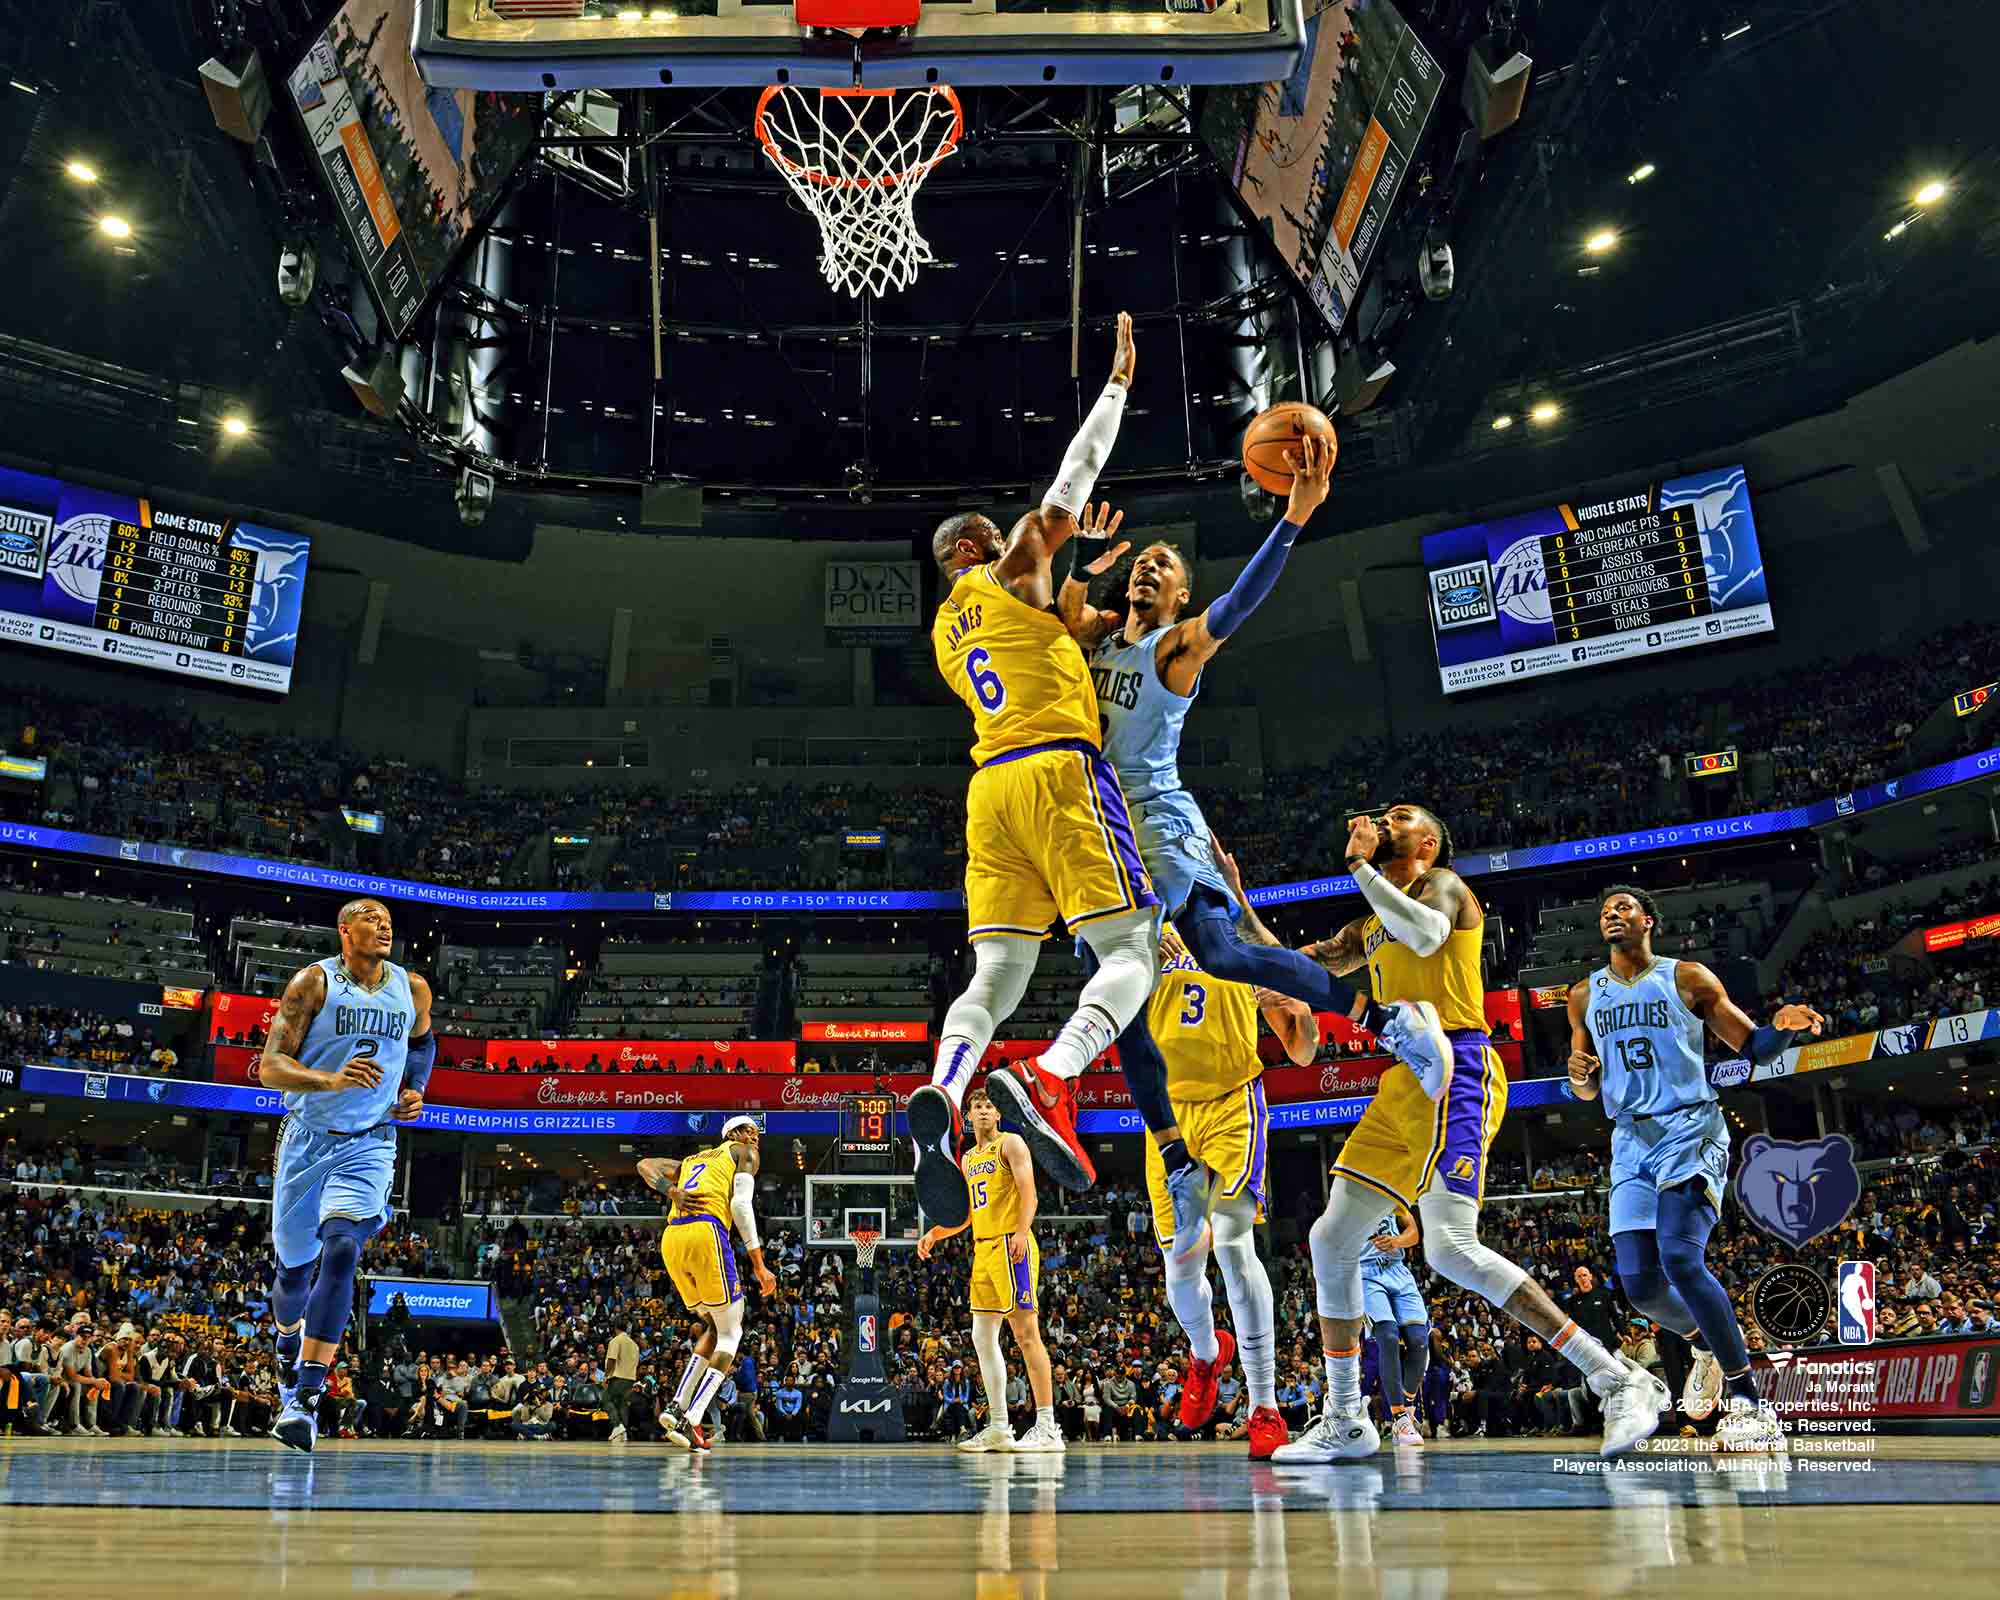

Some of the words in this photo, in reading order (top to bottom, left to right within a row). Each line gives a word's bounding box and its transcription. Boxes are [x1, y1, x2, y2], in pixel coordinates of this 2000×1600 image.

[1388, 77, 1417, 129] 7:00
[154, 512, 186, 531] GAME
[188, 519, 222, 537] STATS
[1578, 501, 1615, 521] HUSTLE
[1617, 494, 1648, 512] STATS
[117, 524, 140, 539] 60%
[150, 531, 176, 547] FIELD
[178, 538, 210, 554] GOALS
[211, 546, 220, 556] %
[230, 549, 250, 563] 45%
[1556, 536, 1564, 549] 0
[1574, 528, 1595, 545] 2ND
[1597, 521, 1638, 540] CHANCE
[1639, 515, 1660, 529] PTS
[1672, 511, 1680, 523] 4
[1558, 552, 1566, 564] 2
[1579, 536, 1638, 559] FASTBREAK
[1639, 530, 1660, 545] PTS
[1675, 526, 1683, 538] 0
[113, 555, 134, 569] 0-2
[161, 565, 184, 581] 3-PT
[185, 571, 199, 584] FG
[230, 580, 245, 593] 1-3
[120, 541, 136, 554] 1-2
[148, 547, 172, 562] FREE
[174, 552, 216, 571] THROWS
[229, 564, 247, 578] 2-2
[1517, 559, 1539, 570] LOS
[1561, 566, 1569, 578] 6
[1601, 550, 1644, 570] ASSISTS
[1678, 542, 1686, 553] 3
[1594, 564, 1656, 587] TURNOVERS
[1681, 557, 1689, 569] 2
[113, 571, 129, 585] 0%
[153, 579, 176, 595] 3-PT
[178, 585, 191, 598] FG
[192, 588, 201, 600] %
[223, 594, 243, 609] 33%
[1437, 569, 1481, 591] BUILT
[1567, 597, 1574, 609] 4
[1586, 591, 1602, 605] PTS
[1603, 586, 1618, 601] OFF
[1619, 577, 1670, 599] TURNOVERS
[1683, 572, 1692, 585] 0
[115, 587, 122, 599] 4
[147, 594, 202, 616] REBOUNDS
[227, 610, 235, 622] 5
[1442, 601, 1488, 622] TOUGH
[1611, 597, 1649, 616] STEALS
[1686, 588, 1695, 600] 0
[107, 618, 119, 631] 10
[130, 622, 167, 641] POINTS
[168, 629, 179, 642] IN
[180, 633, 209, 649] PAINT
[222, 641, 230, 653] 6
[112, 603, 120, 614] 2
[152, 610, 193, 630] BLOCKS
[224, 626, 233, 637] 0
[946, 604, 982, 651] JAMES
[1572, 627, 1580, 639] 3
[1614, 613, 1651, 631] DUNKS
[966, 647, 1005, 713] 6
[1574, 838, 1621, 856] FORD
[1691, 820, 1753, 838] TRUCK
[256, 864, 318, 882] OFFICIAL
[321, 873, 365, 889] TRUCK
[369, 881, 386, 892] OF
[390, 884, 415, 896] THE
[418, 889, 477, 905] MEMPHIS
[481, 896, 547, 907] GRIZZLIES
[732, 896, 775, 905] FORD
[836, 896, 889, 905] TRUCK
[1249, 884, 1309, 903] MEMPHIS
[1181, 983, 1206, 1025] 3
[1594, 1000, 1669, 1038] GRIZZLIES
[336, 1005, 407, 1040] GRIZZLIES
[1949, 1017, 1968, 1041] 13
[352, 1039, 378, 1059] 2
[1616, 1036, 1654, 1072] 13
[1710, 1064, 1749, 1081] LAKERS
[615, 1091, 684, 1105] FanDeck
[857, 1101, 886, 1114] 7:00
[422, 1111, 450, 1124] THE
[455, 1114, 529, 1128] MEMPHIS
[534, 1117, 616, 1128] GRIZZLIES
[860, 1116, 882, 1139] 19
[1280, 1109, 1311, 1122] THE
[684, 1163, 706, 1190] 2
[971, 1181, 987, 1209] 15
[1884, 1357, 1919, 1402] NBA
[1920, 1353, 1958, 1402] APP
